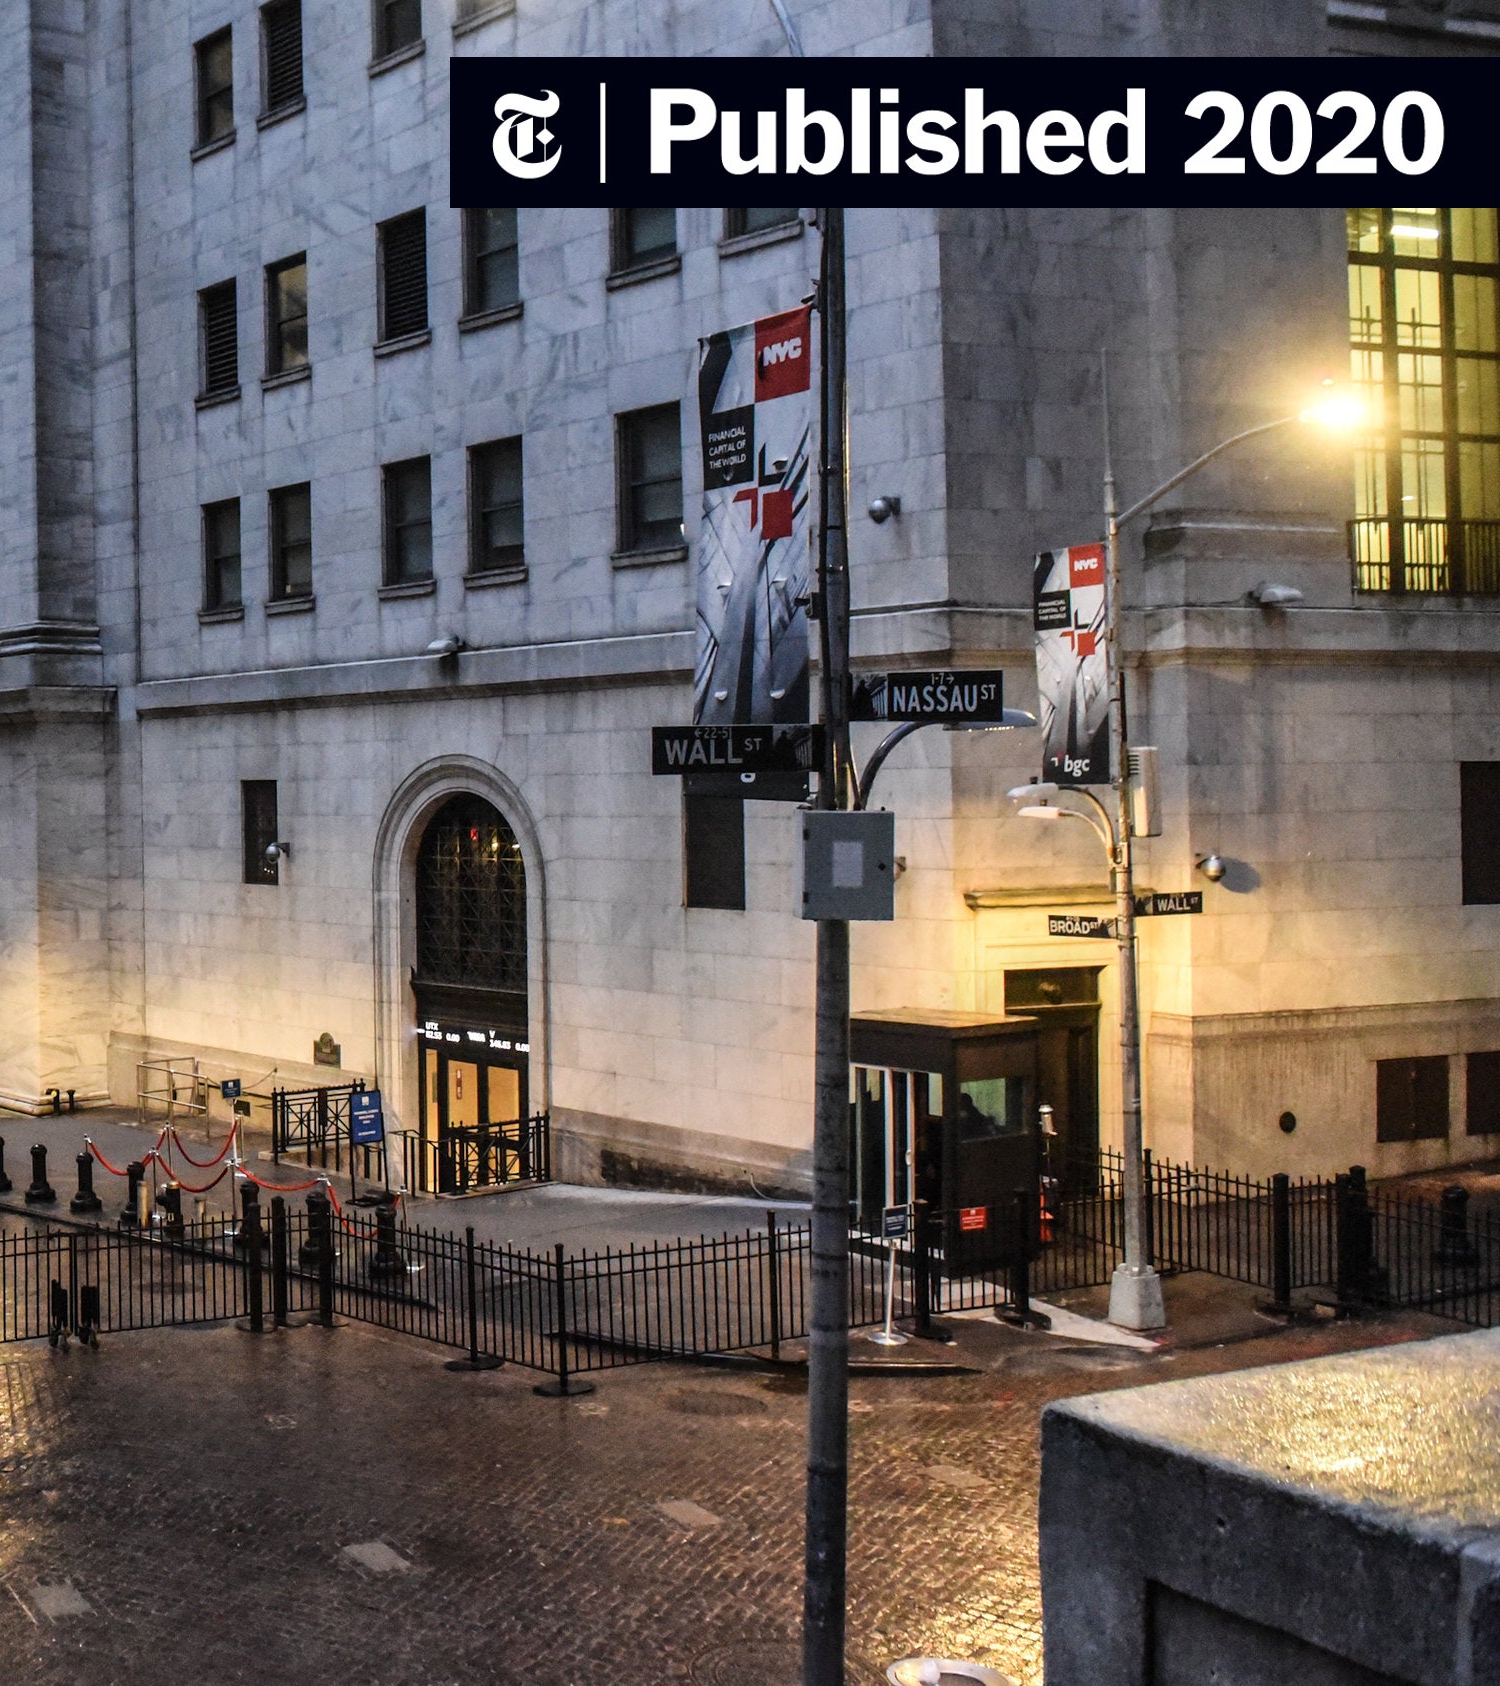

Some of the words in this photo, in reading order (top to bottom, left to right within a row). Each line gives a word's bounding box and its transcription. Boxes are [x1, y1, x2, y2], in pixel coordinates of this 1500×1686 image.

[763, 337, 802, 367] NYC
[708, 426, 746, 443] FINANCIAL
[708, 443, 735, 457] CAPITAL
[735, 439, 747, 451] OF
[709, 458, 722, 470] THE
[721, 453, 747, 468] WORLD
[1073, 557, 1098, 571] NYC
[931, 673, 945, 685] 1-7
[892, 684, 978, 713] NASSAU
[980, 683, 996, 700] ST
[664, 738, 743, 766] WALL
[744, 738, 763, 751] ST
[1063, 754, 1091, 777] bgc
[1157, 896, 1191, 912] WALL
[1050, 919, 1090, 934] BROAD
[1090, 922, 1098, 930] ST
[426, 1022, 438, 1030] UTX
